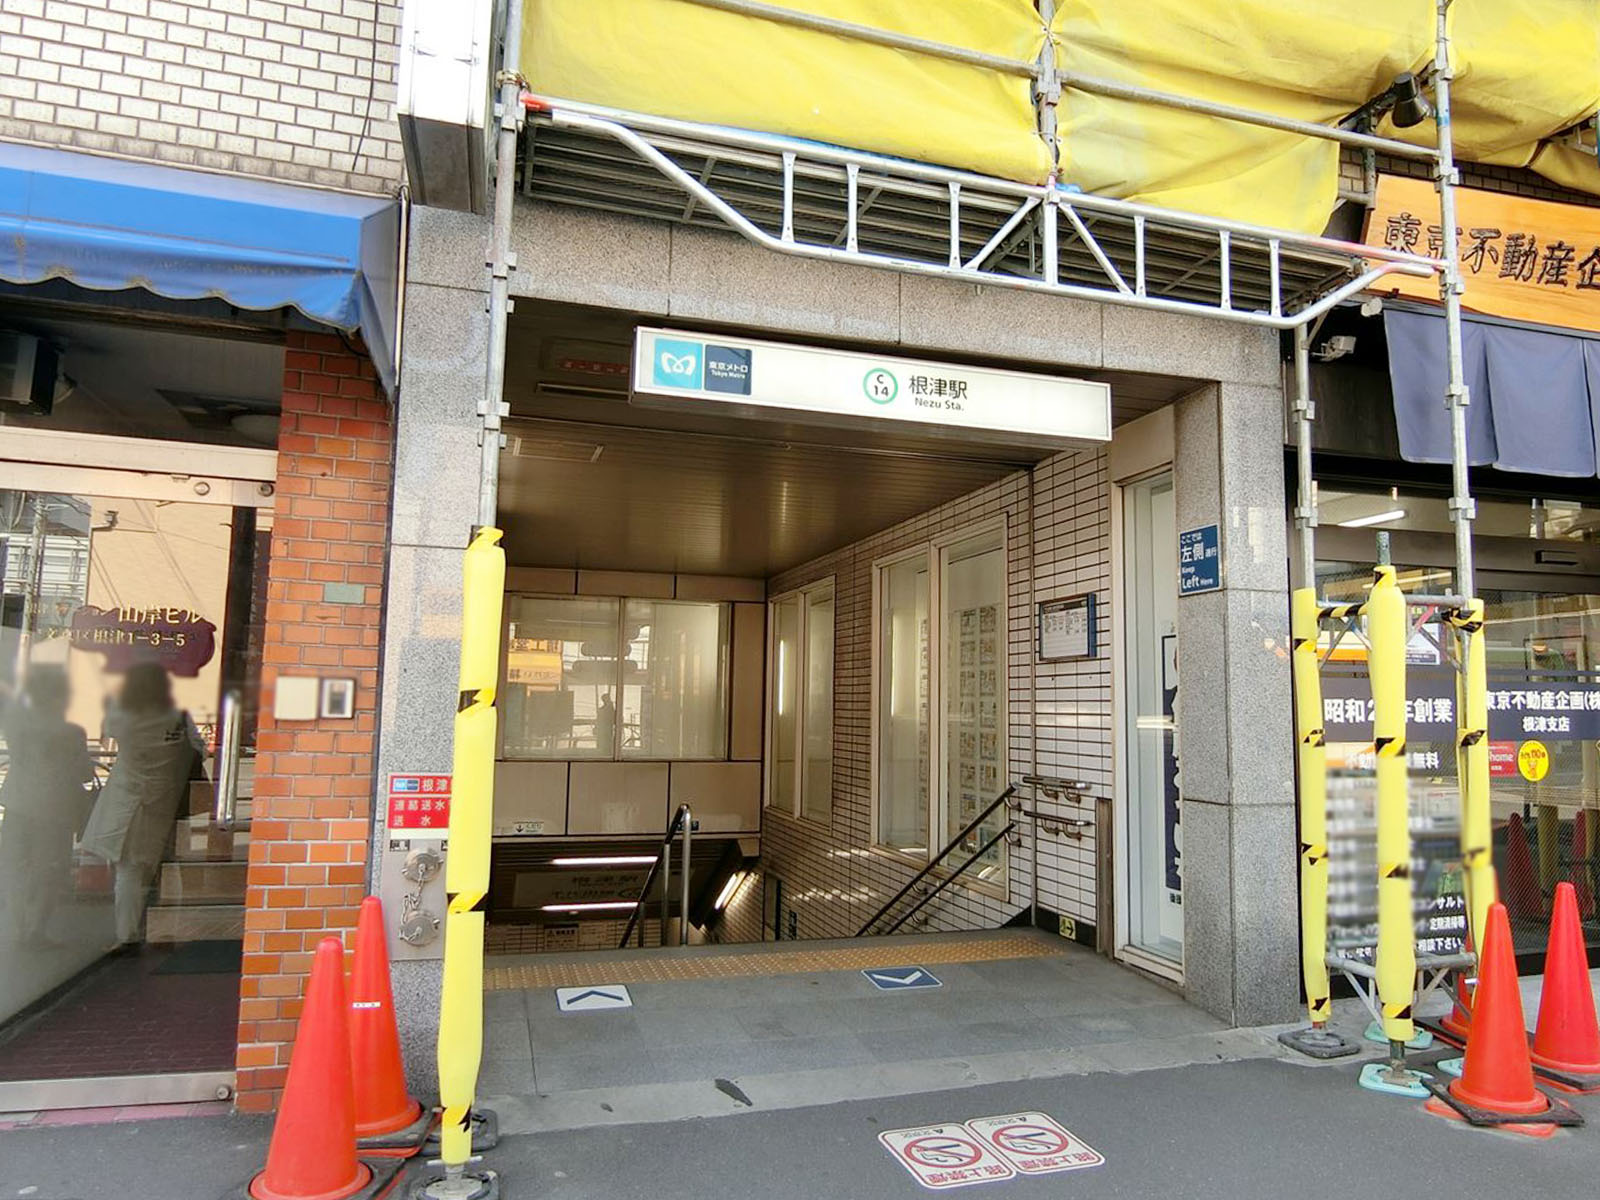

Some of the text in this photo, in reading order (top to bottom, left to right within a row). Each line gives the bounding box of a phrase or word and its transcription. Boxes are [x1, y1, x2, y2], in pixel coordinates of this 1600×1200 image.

[709, 361, 748, 373] 東京メトロ
[711, 369, 746, 379] Tokyo Metro
[876, 374, 884, 384] C
[874, 385, 889, 397] 14
[908, 375, 968, 400] 根津駅
[914, 397, 965, 411] Nezu Sta.
[1182, 575, 1200, 589] Left
[117, 605, 203, 626] 山岸ビル
[1324, 698, 1453, 723] 昭和2創業
